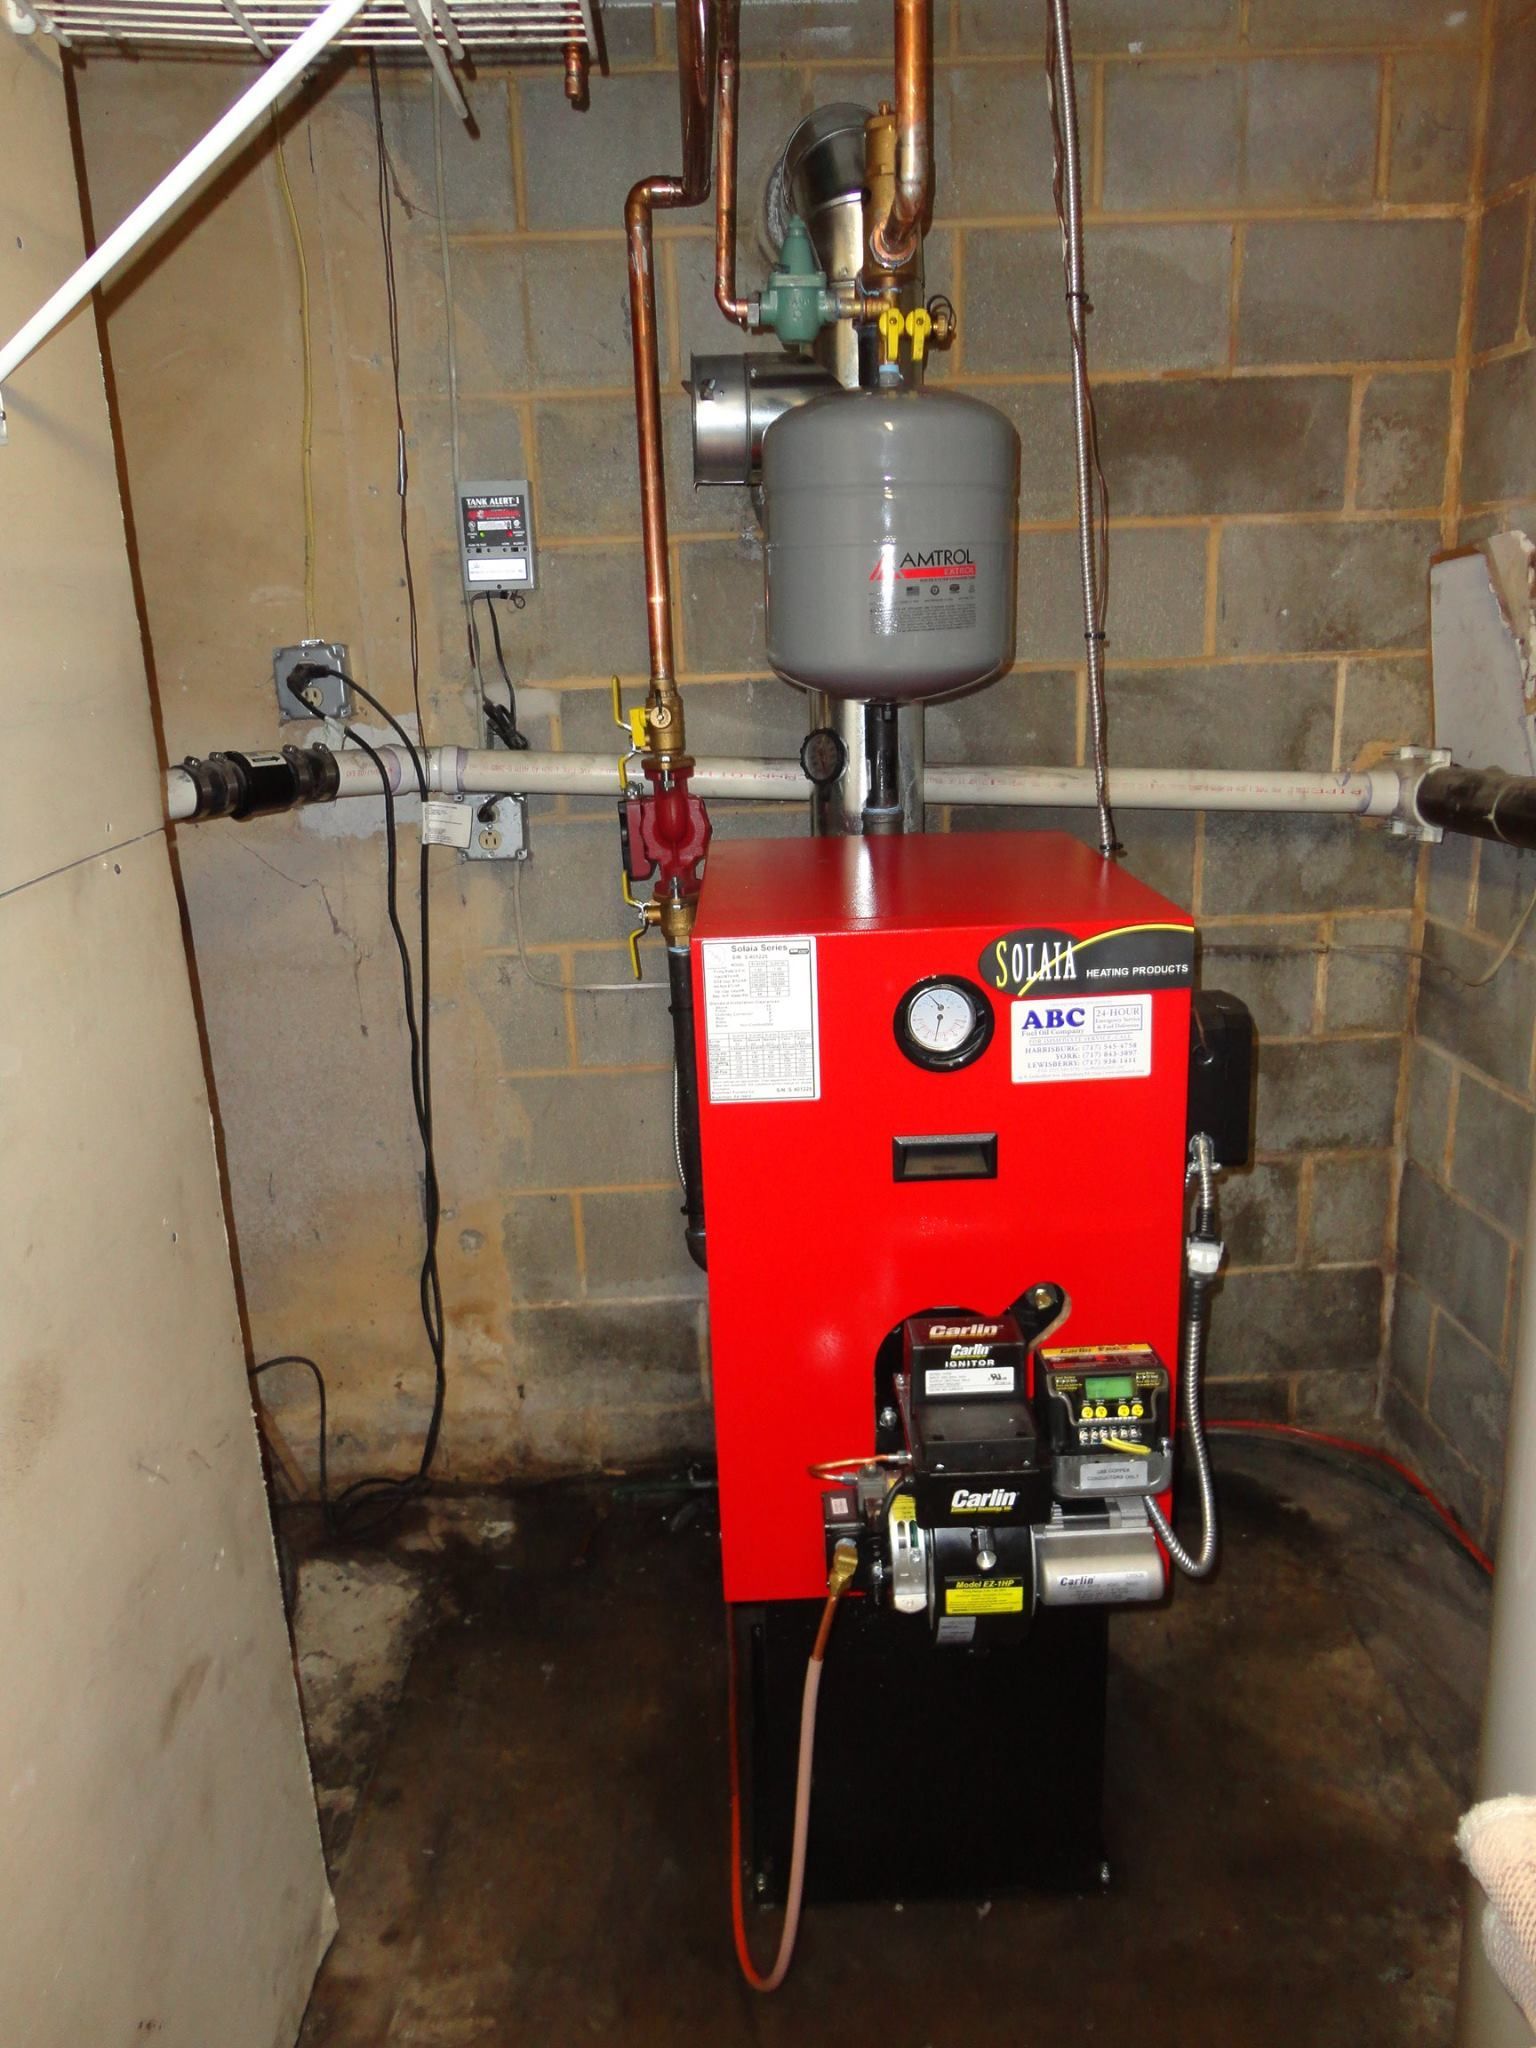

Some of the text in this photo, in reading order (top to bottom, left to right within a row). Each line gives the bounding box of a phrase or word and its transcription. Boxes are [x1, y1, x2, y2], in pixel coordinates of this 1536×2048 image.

[466, 497, 488, 506] TANK
[489, 496, 513, 505] ALERT
[900, 549, 973, 568] AMTROL
[944, 566, 974, 576] EXTROL
[731, 944, 758, 953] Solaia
[760, 944, 788, 952] Series
[996, 940, 1189, 987] SOLAIA HEATING PRODUCTS
[1021, 1007, 1085, 1030] ABC
[1050, 1028, 1085, 1036] Company
[929, 1323, 998, 1336] Carlin
[950, 1343, 990, 1356] Carlin
[945, 1359, 995, 1369] IGNITOR
[951, 1488, 1017, 1508] Carlin
[955, 1579, 1015, 1589] Model EZ-1HP
[1060, 1575, 1095, 1586] Carlin
